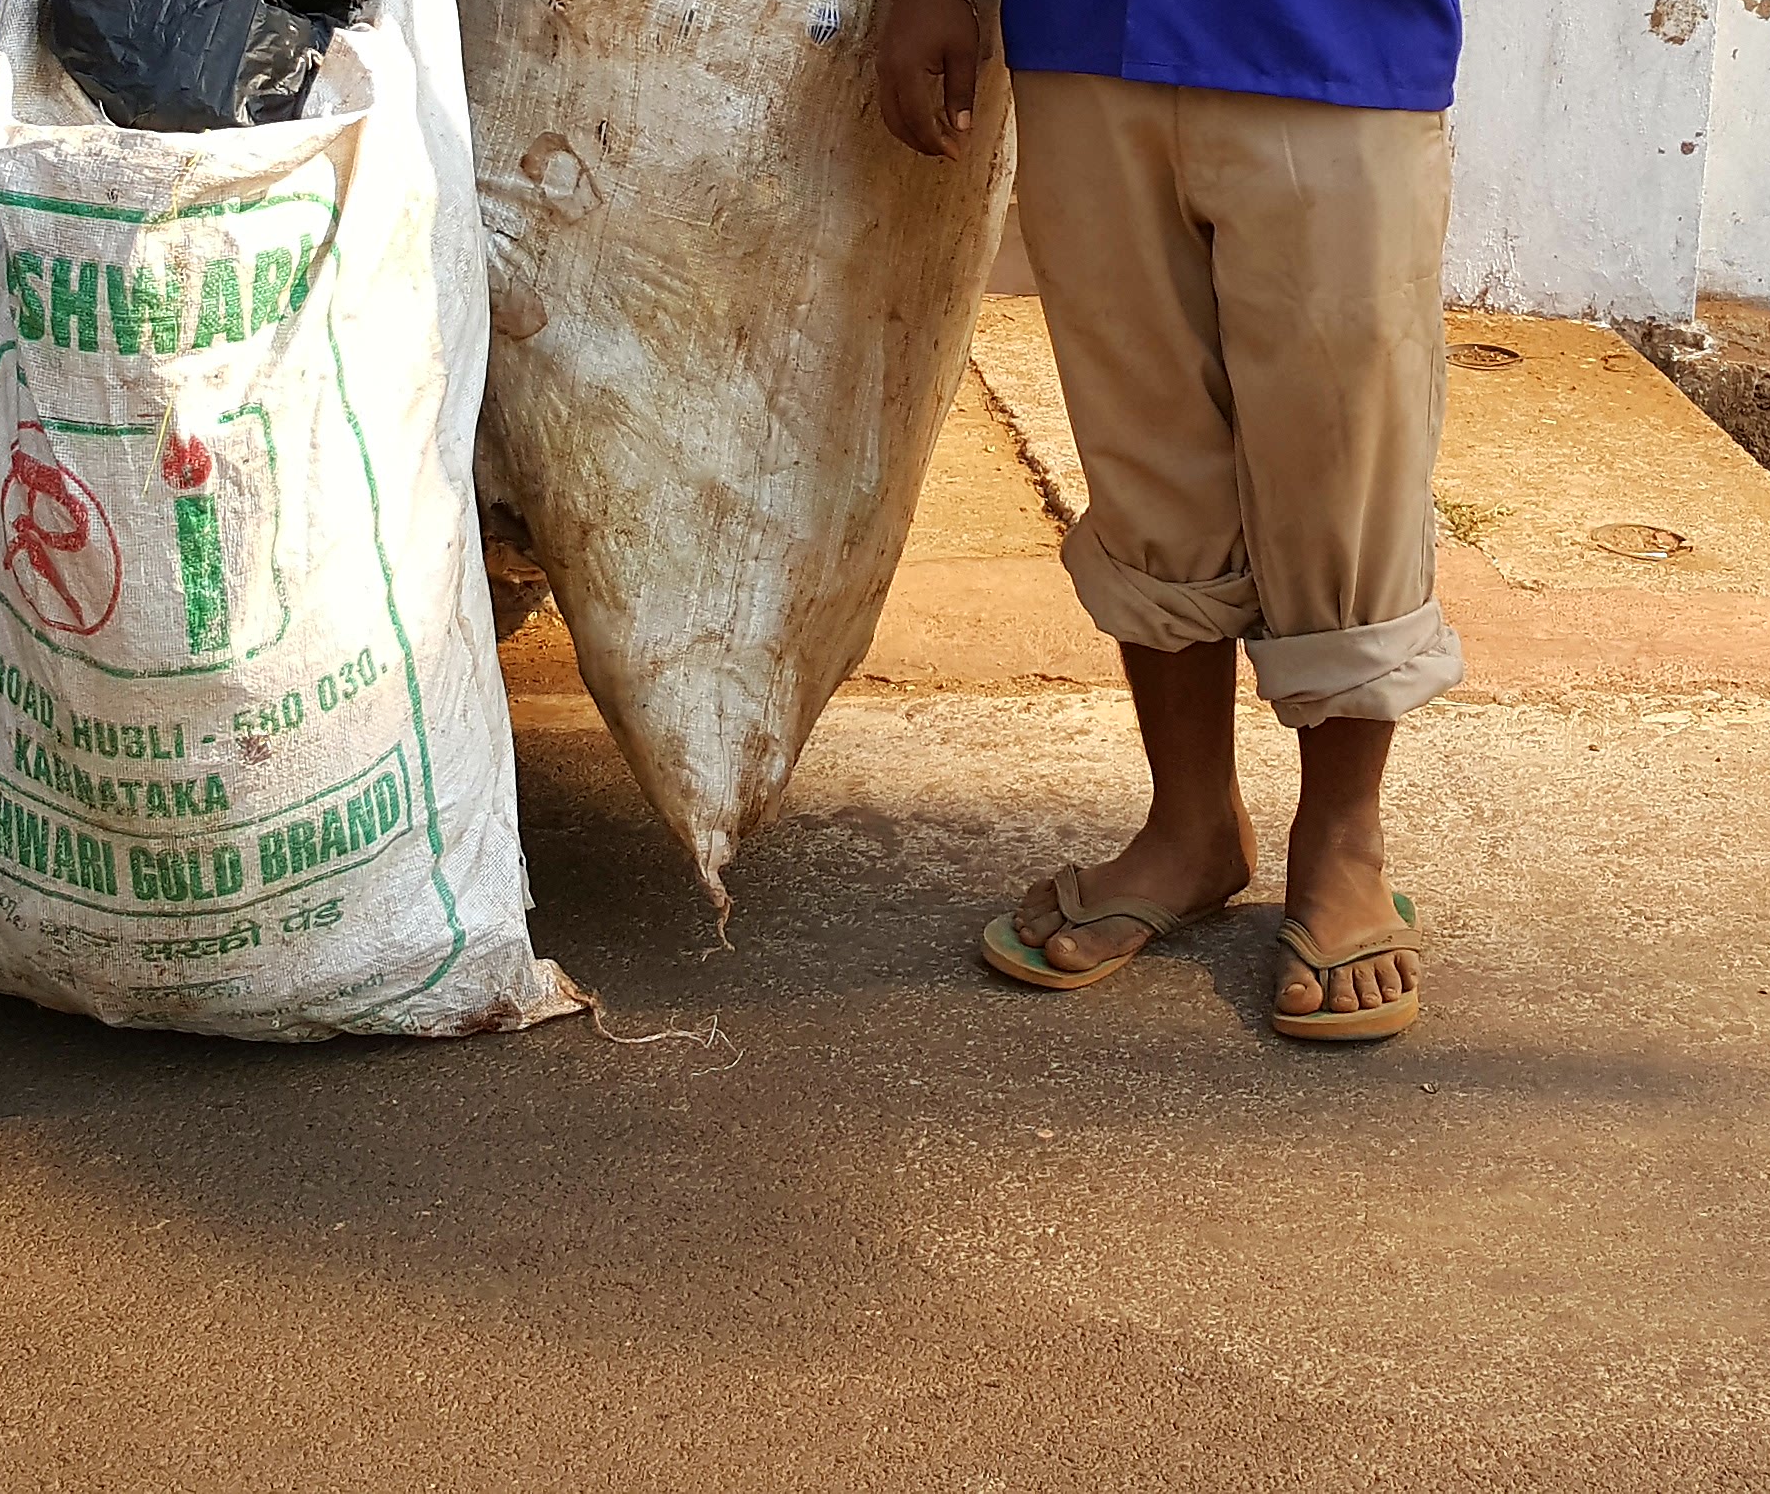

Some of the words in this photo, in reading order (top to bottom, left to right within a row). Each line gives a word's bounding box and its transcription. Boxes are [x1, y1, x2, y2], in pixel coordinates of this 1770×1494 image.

[7, 233, 312, 355] SHWARI
[14, 725, 231, 820] KARNATAKA
[69, 710, 186, 760] HUBLI
[130, 844, 245, 901] GOLD
[258, 770, 403, 886] BRAND
